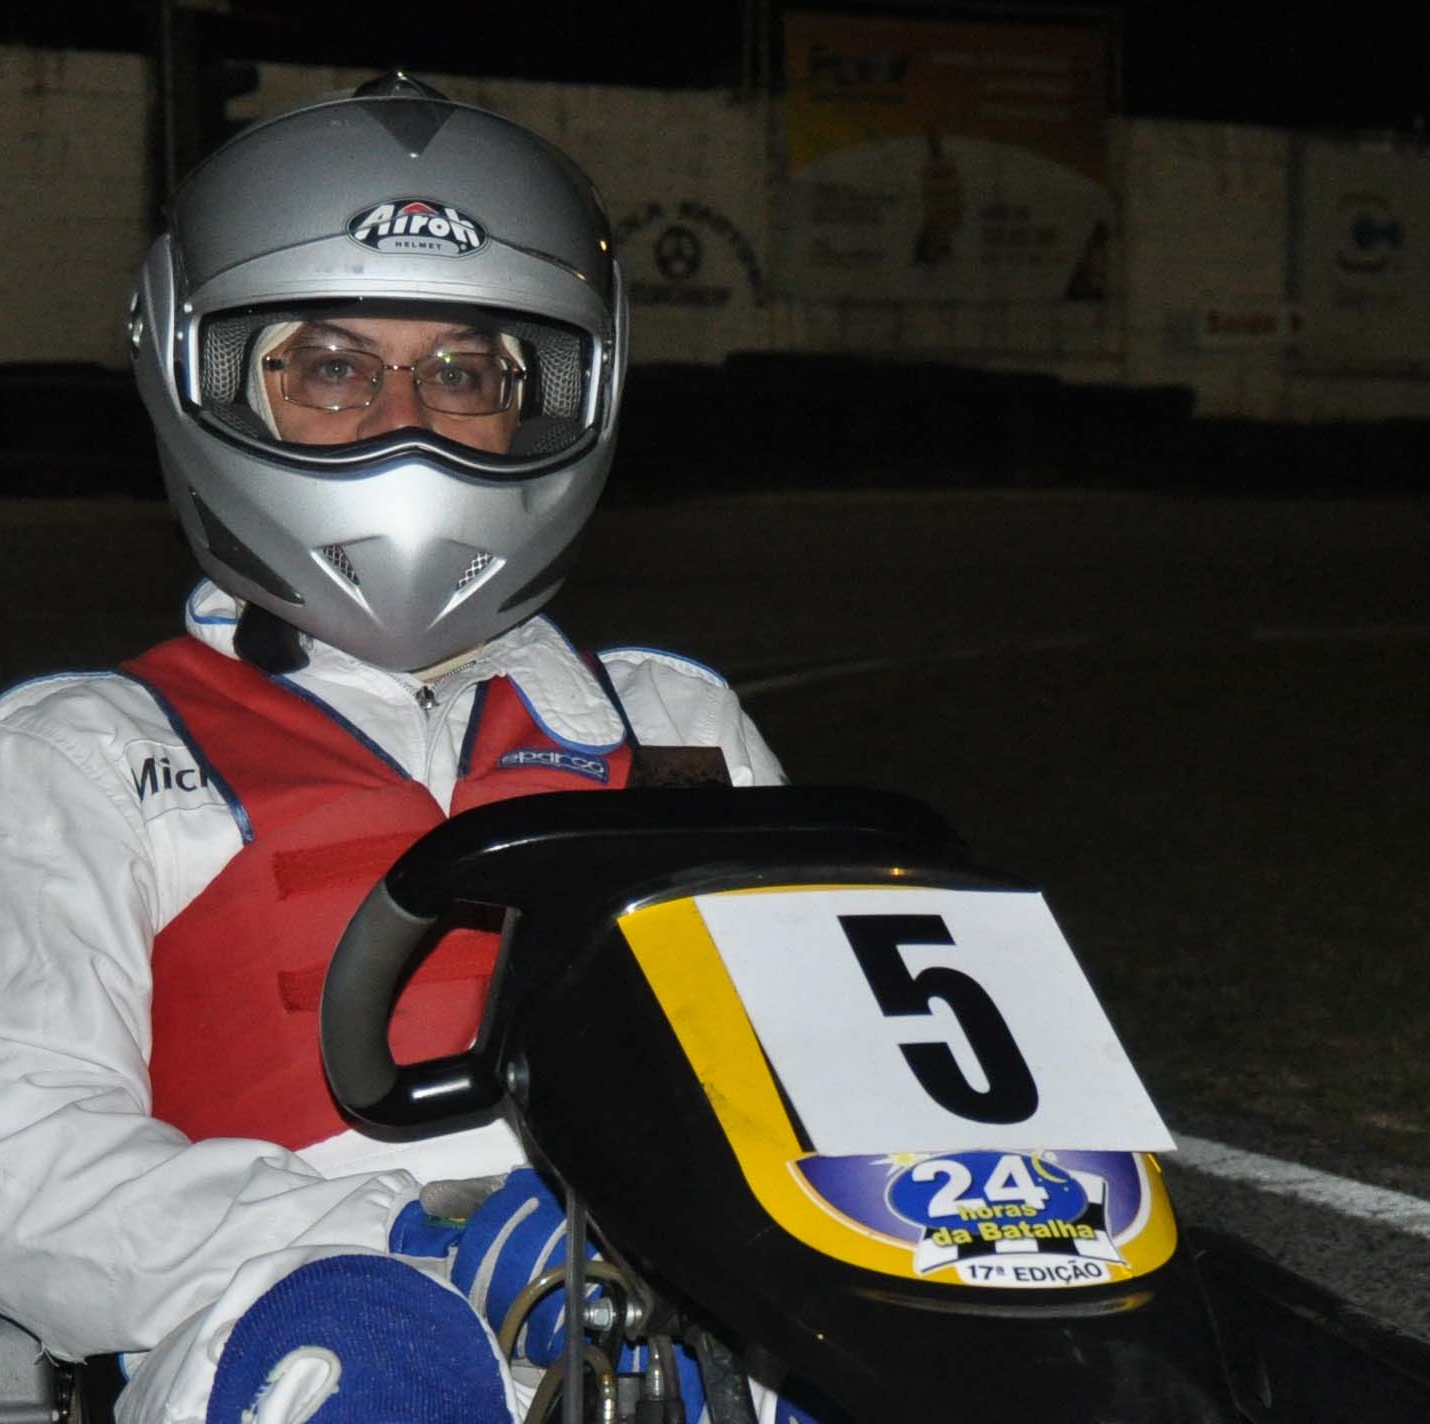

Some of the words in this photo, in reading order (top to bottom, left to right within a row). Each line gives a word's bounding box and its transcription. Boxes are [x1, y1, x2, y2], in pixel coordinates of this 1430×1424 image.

[354, 204, 480, 248] Airoh
[395, 241, 442, 250] HELMET
[836, 914, 1040, 1125] 5
[911, 1154, 1050, 1219] 24
[956, 1203, 1039, 1221] horas
[931, 1226, 973, 1247] da
[977, 1220, 1097, 1242] Batalha
[967, 1264, 1005, 1281] 17ª
[1014, 1259, 1103, 1284] EDIÇÃO
